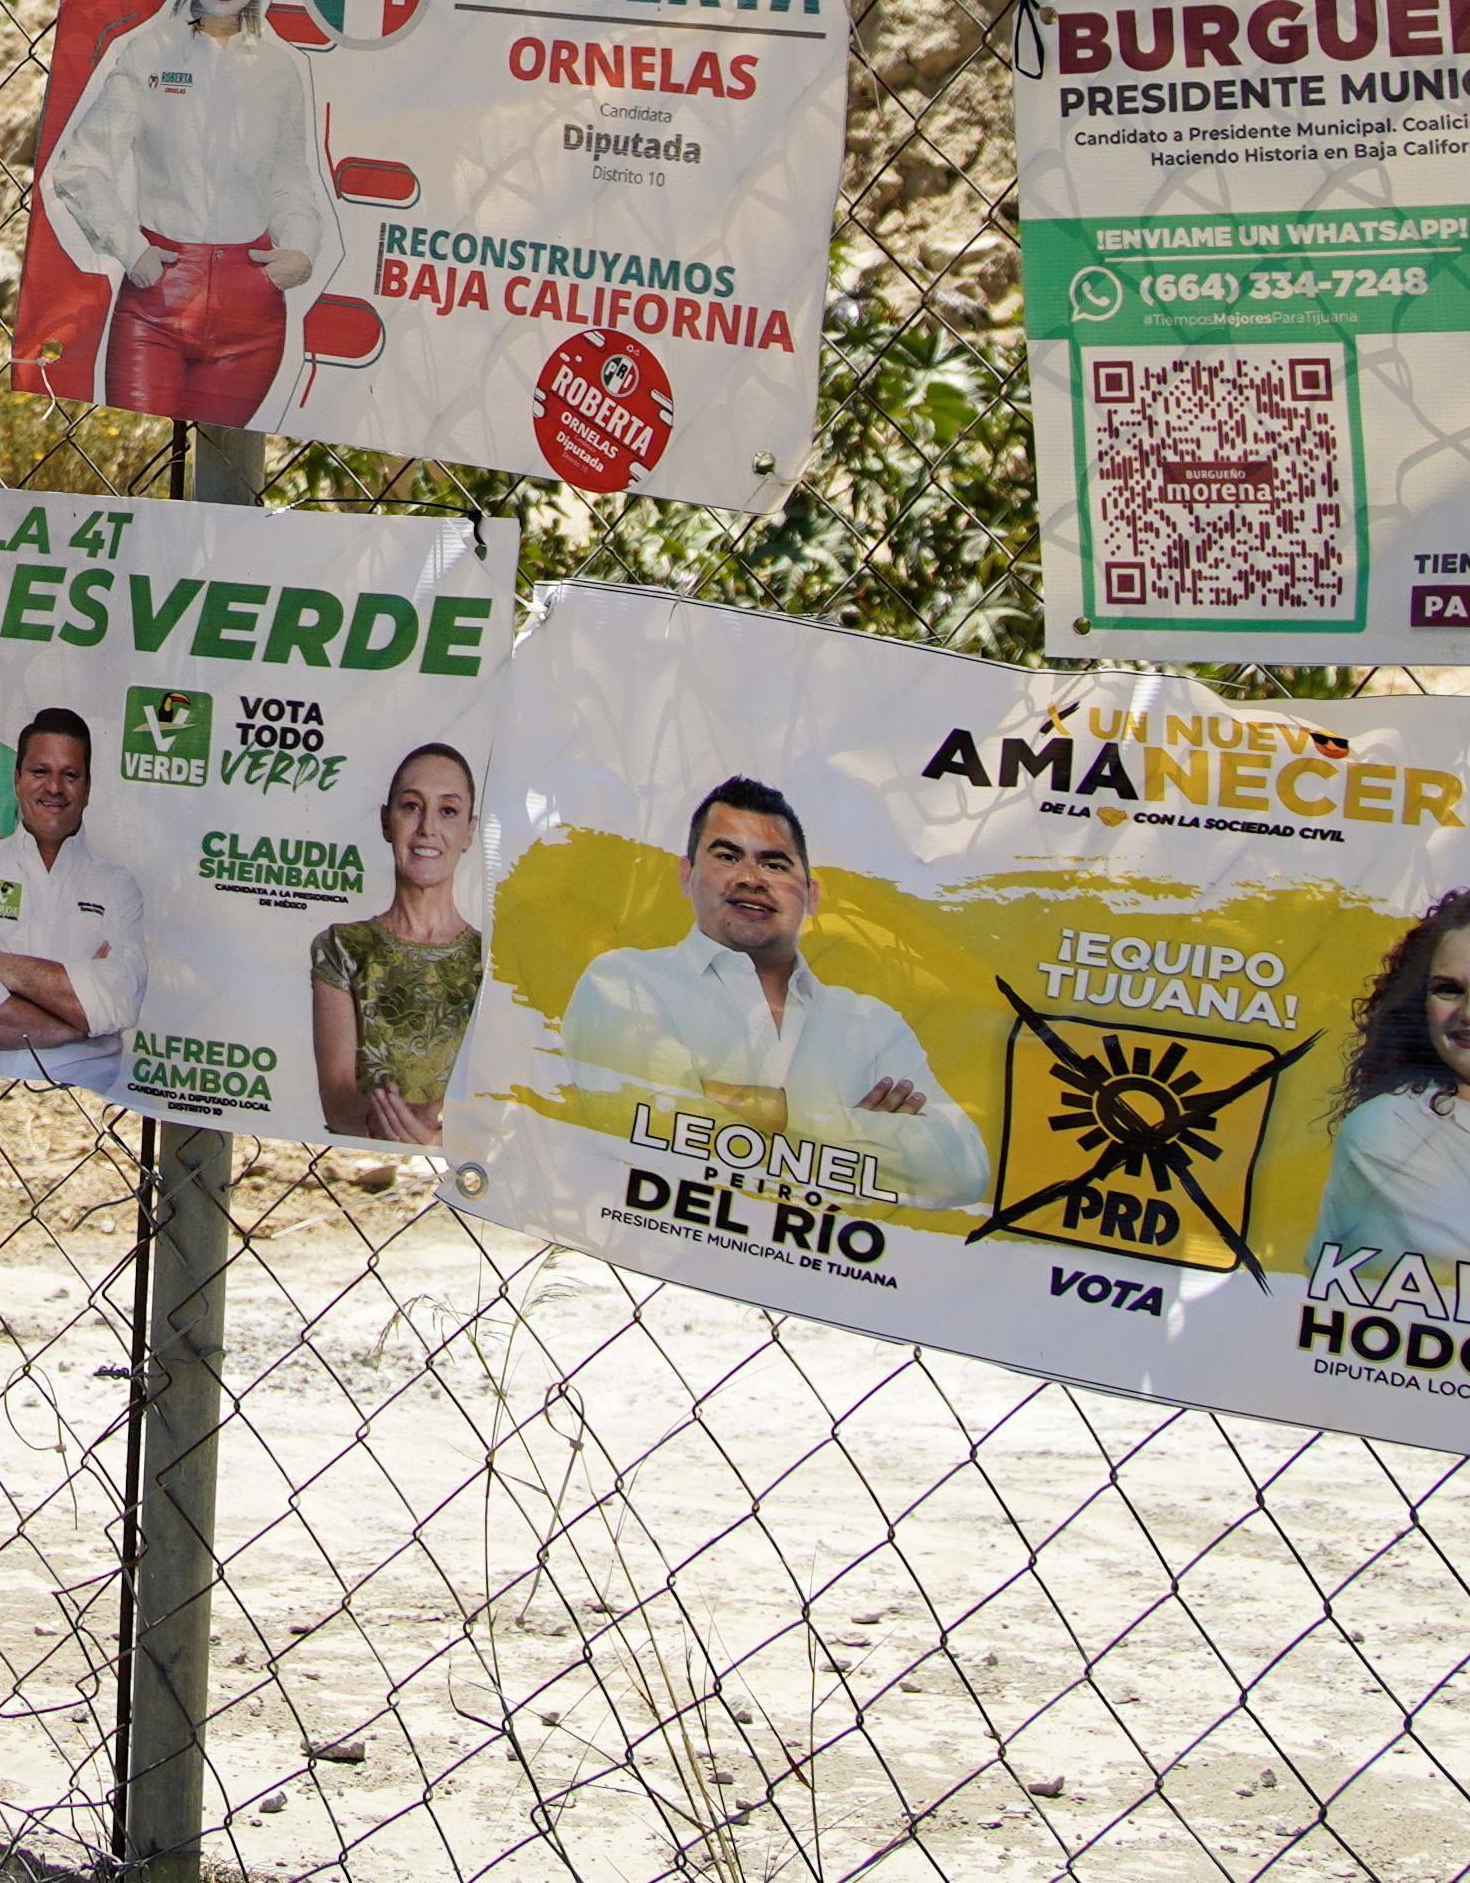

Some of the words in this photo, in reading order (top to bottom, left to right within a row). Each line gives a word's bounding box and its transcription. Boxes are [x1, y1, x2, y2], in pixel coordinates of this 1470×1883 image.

[508, 35, 759, 101] ORNELAS
[600, 103, 672, 123] Candidata
[1061, 74, 1325, 117] PRESIDENTE
[563, 123, 701, 165] Diputada
[1075, 129, 1167, 146] Candidato
[1173, 132, 1182, 142] a
[1190, 124, 1291, 141] Presidente
[1297, 117, 1396, 141] Municipal.
[1151, 150, 1238, 166] Haciendo
[1245, 146, 1318, 163] Historia
[1325, 147, 1347, 159] en
[1354, 142, 1397, 160] Baja
[592, 165, 643, 184] Distrito
[649, 171, 665, 187] 10
[1240, 225, 1279, 247] UN
[1286, 217, 1469, 245] WHATSAPP!
[386, 223, 736, 298] RECONSTRUYAMOS
[380, 258, 490, 316] BAJA
[504, 275, 795, 353] CALIFORNIA
[1139, 270, 1239, 307] (664)
[1253, 266, 1428, 299] 334-7248
[68, 509, 134, 559] 4T
[0, 565, 116, 647] ES
[127, 575, 492, 677] VERDE
[240, 696, 324, 725] VOTA
[236, 723, 324, 751] TODO
[125, 752, 205, 784] VERDE
[221, 740, 347, 795] VERDE
[921, 728, 1466, 828] AMANECER
[1040, 801, 1064, 815] DE
[1068, 804, 1091, 819] LA
[1134, 811, 1175, 827] CON
[1179, 815, 1200, 829] LA
[1204, 818, 1295, 838] SOCIEDAD
[1299, 826, 1346, 843] CIVIL
[202, 831, 365, 872] CLAUDIA
[199, 858, 363, 893] SHEINBAUM
[1057, 928, 1284, 988] ¡EQUIPO
[1038, 962, 1298, 1030] TIJUANA!
[133, 1030, 277, 1072] ALFREDO
[133, 1058, 272, 1101] GAMBOA
[630, 1103, 898, 1204] LEONEL
[625, 1168, 749, 1236] DEL
[772, 1203, 885, 1263] RÍO
[1062, 1186, 1180, 1246] PRD
[601, 1207, 703, 1242] PRESIDENTE
[707, 1234, 794, 1265] MUNICIPAL
[799, 1256, 822, 1271] DE
[827, 1262, 898, 1289] TIJUANA
[1050, 1266, 1164, 1317] VOTA
[1314, 1358, 1421, 1390] DIPUTADA
